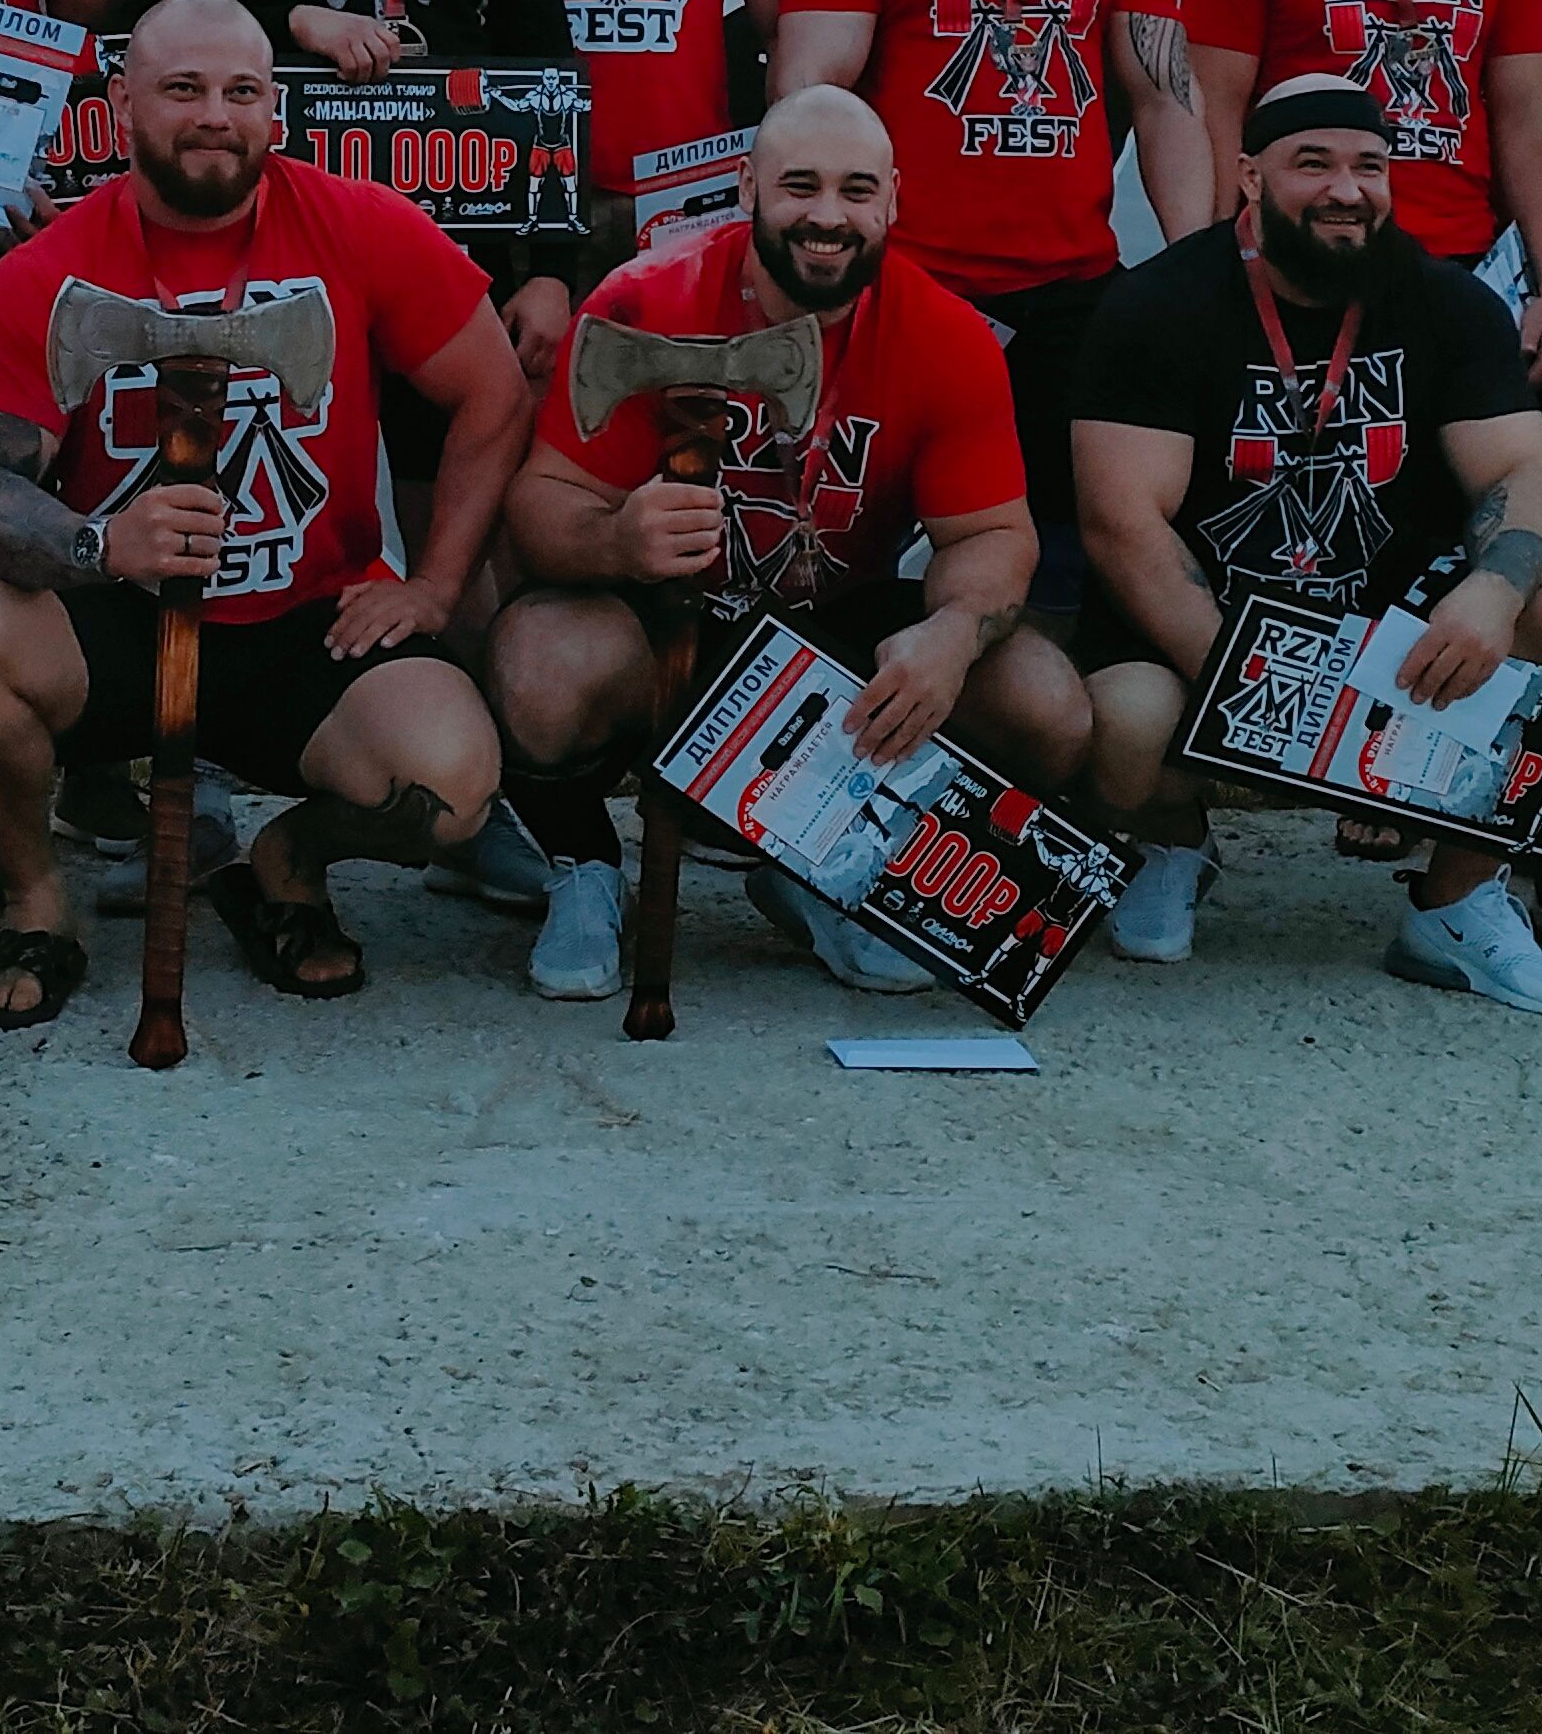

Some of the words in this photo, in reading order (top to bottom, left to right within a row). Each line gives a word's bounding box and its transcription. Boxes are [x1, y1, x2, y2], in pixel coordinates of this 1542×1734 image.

[303, 82, 393, 96] ВСЕРОССИЙСКИЙ
[396, 83, 437, 97] ТУРНИР
[303, 100, 436, 122] «МАНДАРИН»
[305, 127, 373, 182] 10
[655, 132, 745, 173] ДИПЛОМ
[960, 115, 1080, 158] FEST
[1232, 349, 1405, 435] RZN
[685, 654, 780, 767] ДИПЛОМ
[1297, 637, 1356, 749] ДИПЛОМ
[770, 721, 834, 801] НАГРАЖДАЕТСЯ
